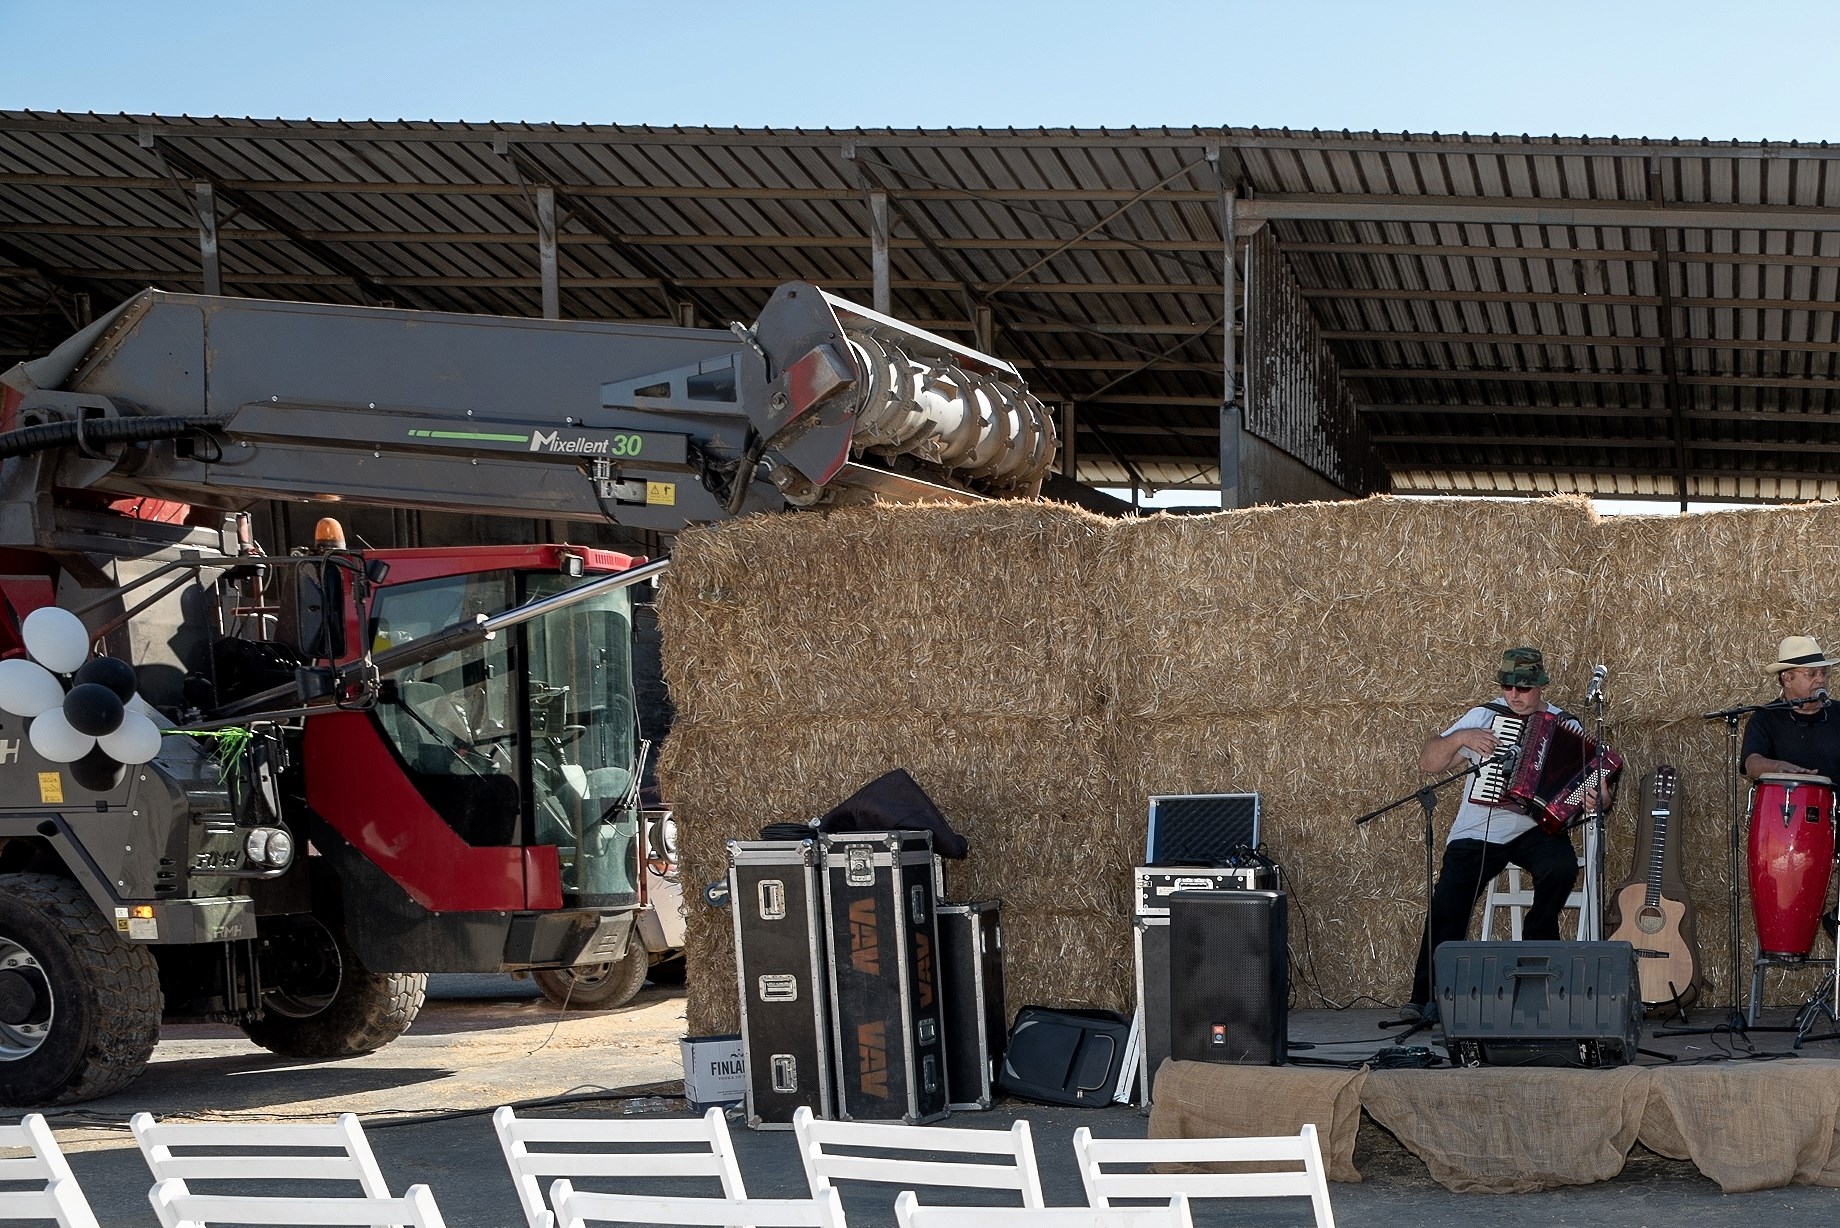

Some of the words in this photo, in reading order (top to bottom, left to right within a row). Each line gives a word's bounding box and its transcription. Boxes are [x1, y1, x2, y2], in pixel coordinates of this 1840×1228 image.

[530, 430, 609, 453] Mixellent
[612, 434, 642, 456] 30
[213, 925, 243, 939] RMH
